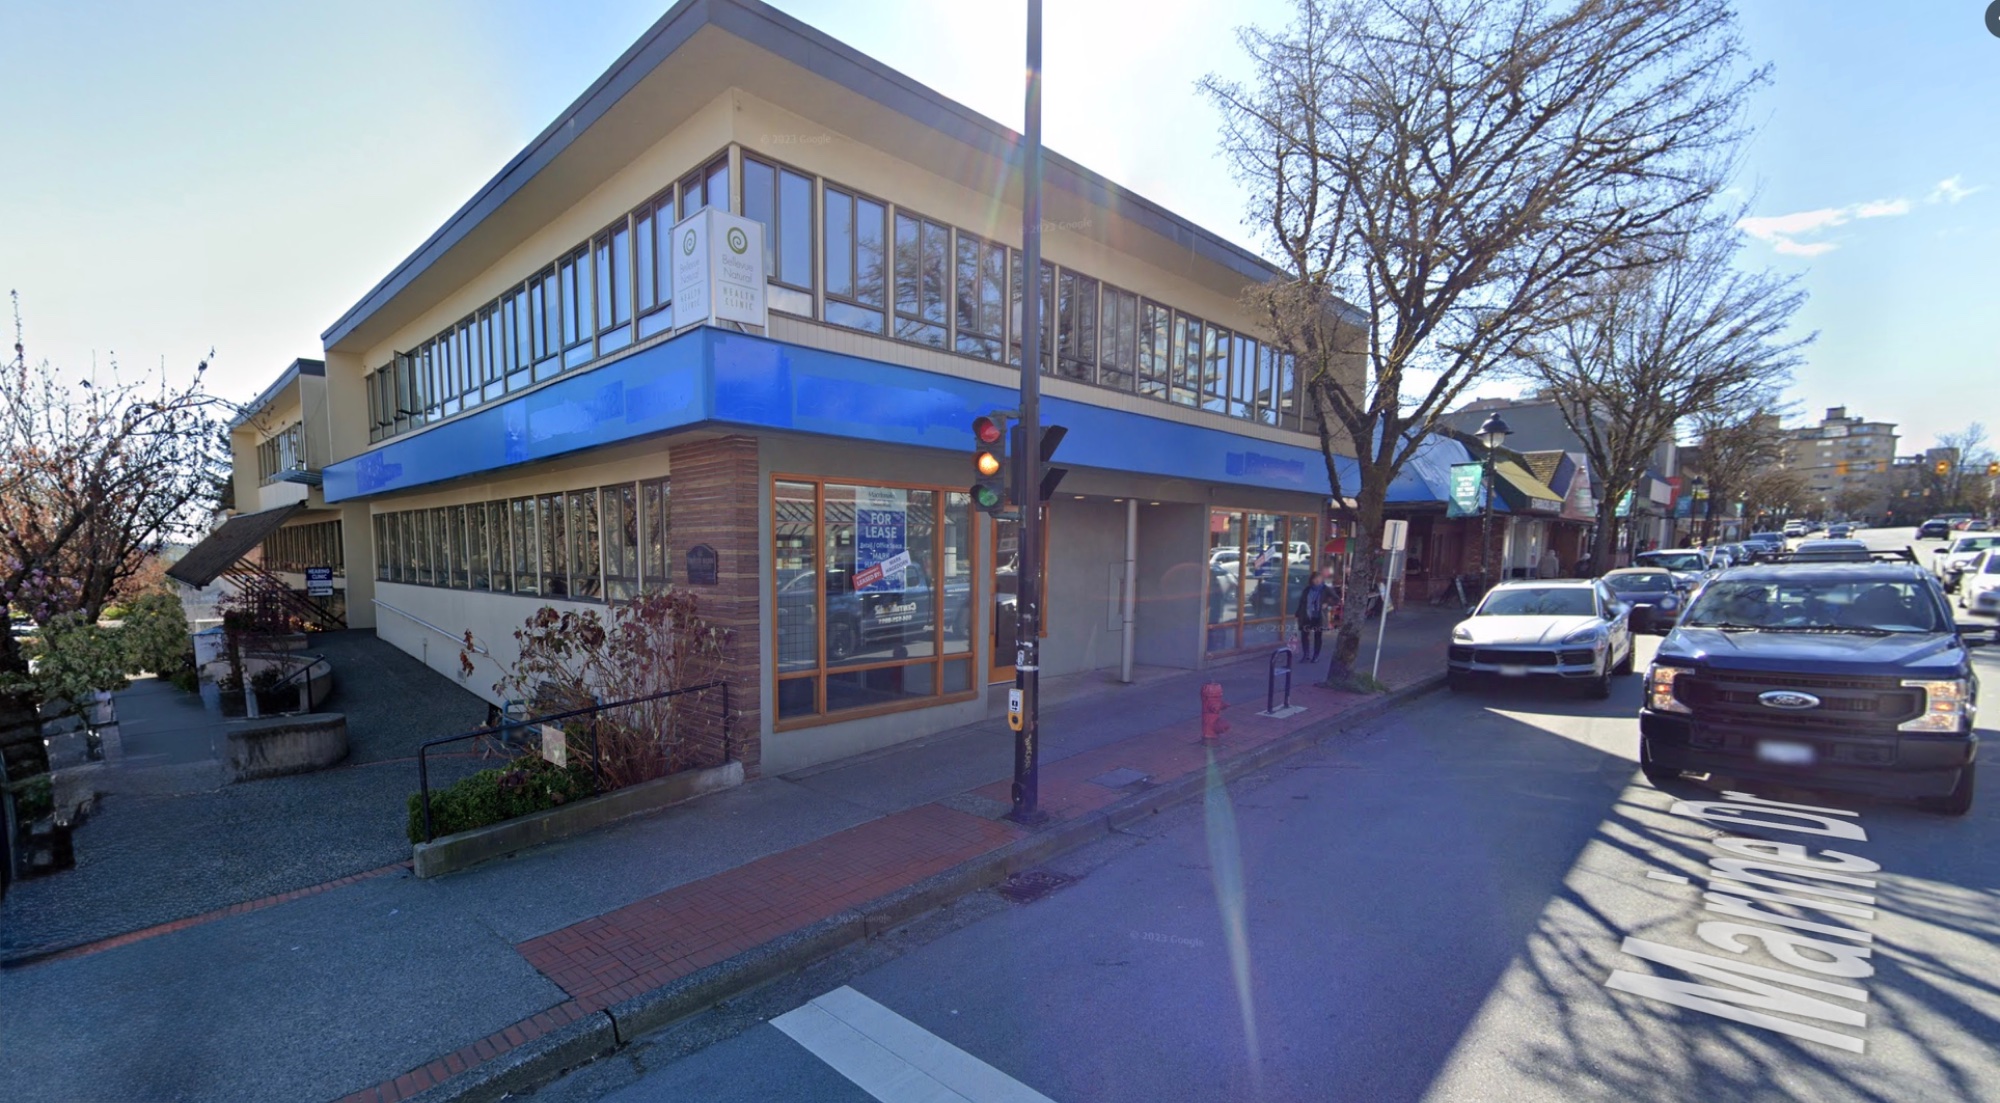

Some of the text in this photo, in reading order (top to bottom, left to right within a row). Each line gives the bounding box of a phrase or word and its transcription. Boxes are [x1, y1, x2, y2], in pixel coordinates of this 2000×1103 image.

[722, 254, 753, 272] Bellevue
[723, 267, 752, 283] Natural
[723, 286, 755, 301] HEALTH
[725, 297, 753, 311] CLINIC
[871, 513, 892, 525] FOR
[865, 526, 897, 539] LEASE
[1773, 694, 1803, 705] Ford
